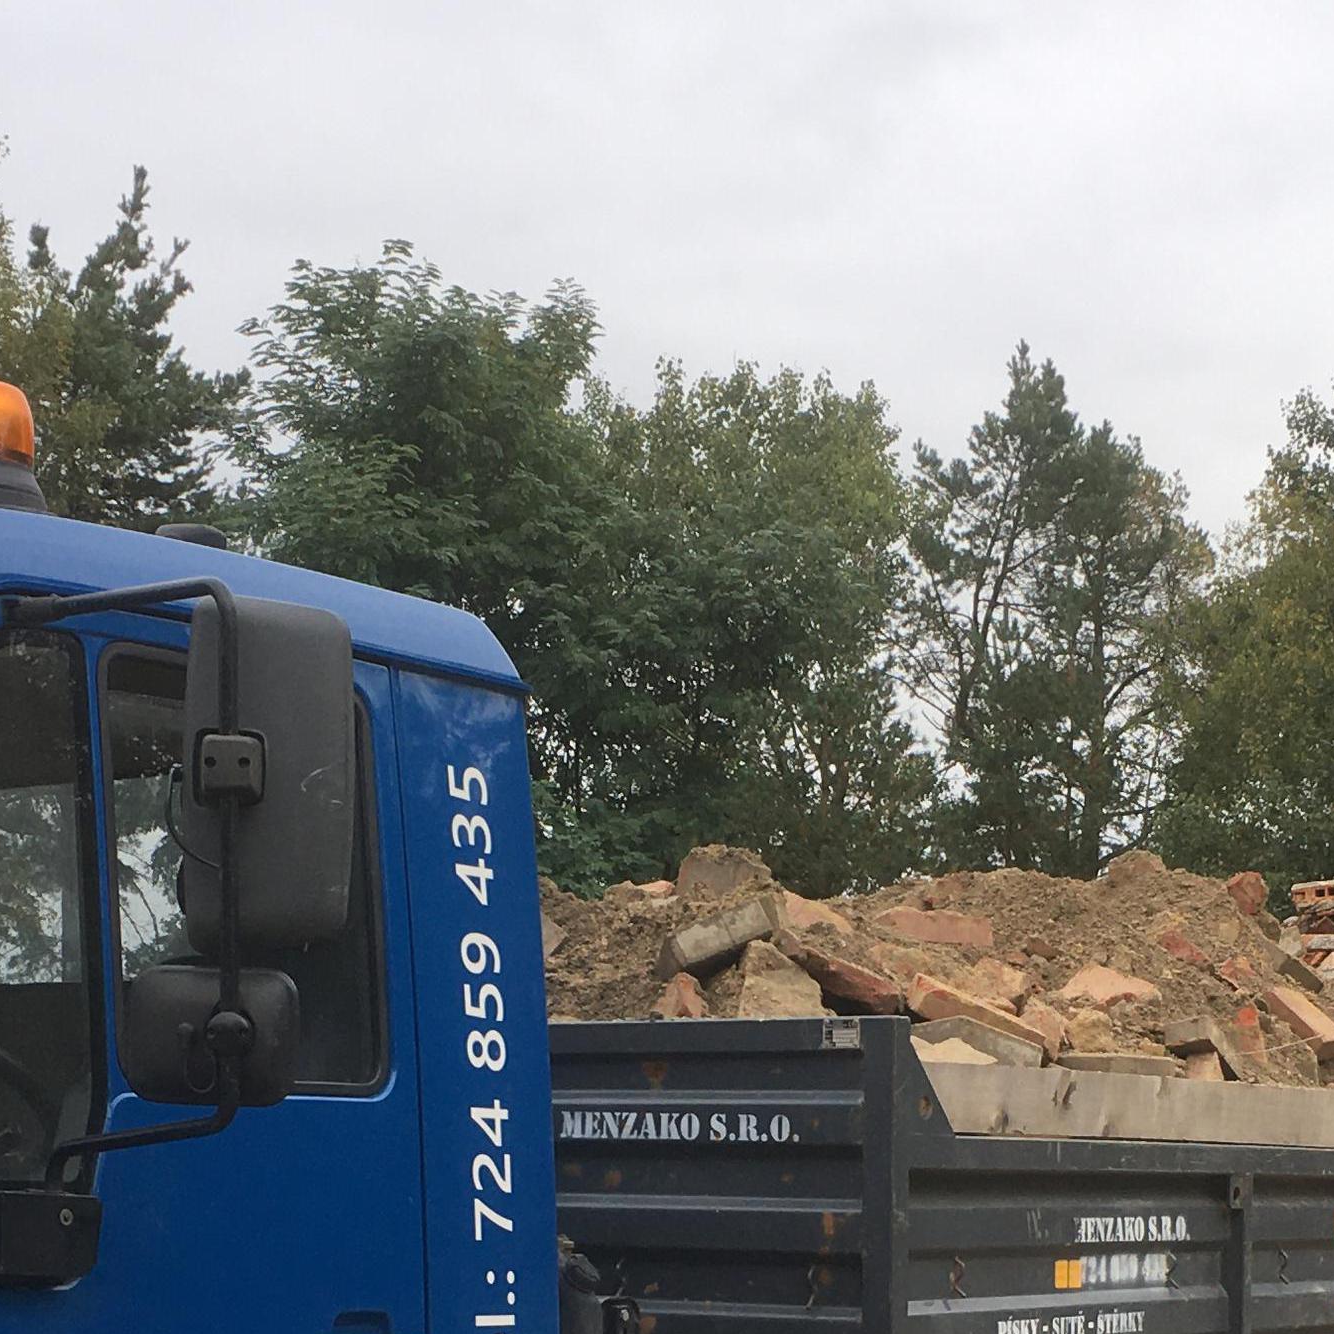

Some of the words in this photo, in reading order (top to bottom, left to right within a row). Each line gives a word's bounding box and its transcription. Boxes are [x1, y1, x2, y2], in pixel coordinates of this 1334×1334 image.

[446, 763, 495, 907] 435
[459, 931, 508, 1074] 859
[470, 1099, 513, 1241] 724
[559, 1110, 700, 1141] MENZAKO
[709, 1113, 800, 1143] S.R.O.
[1148, 1215, 1191, 1242] S.R.O.
